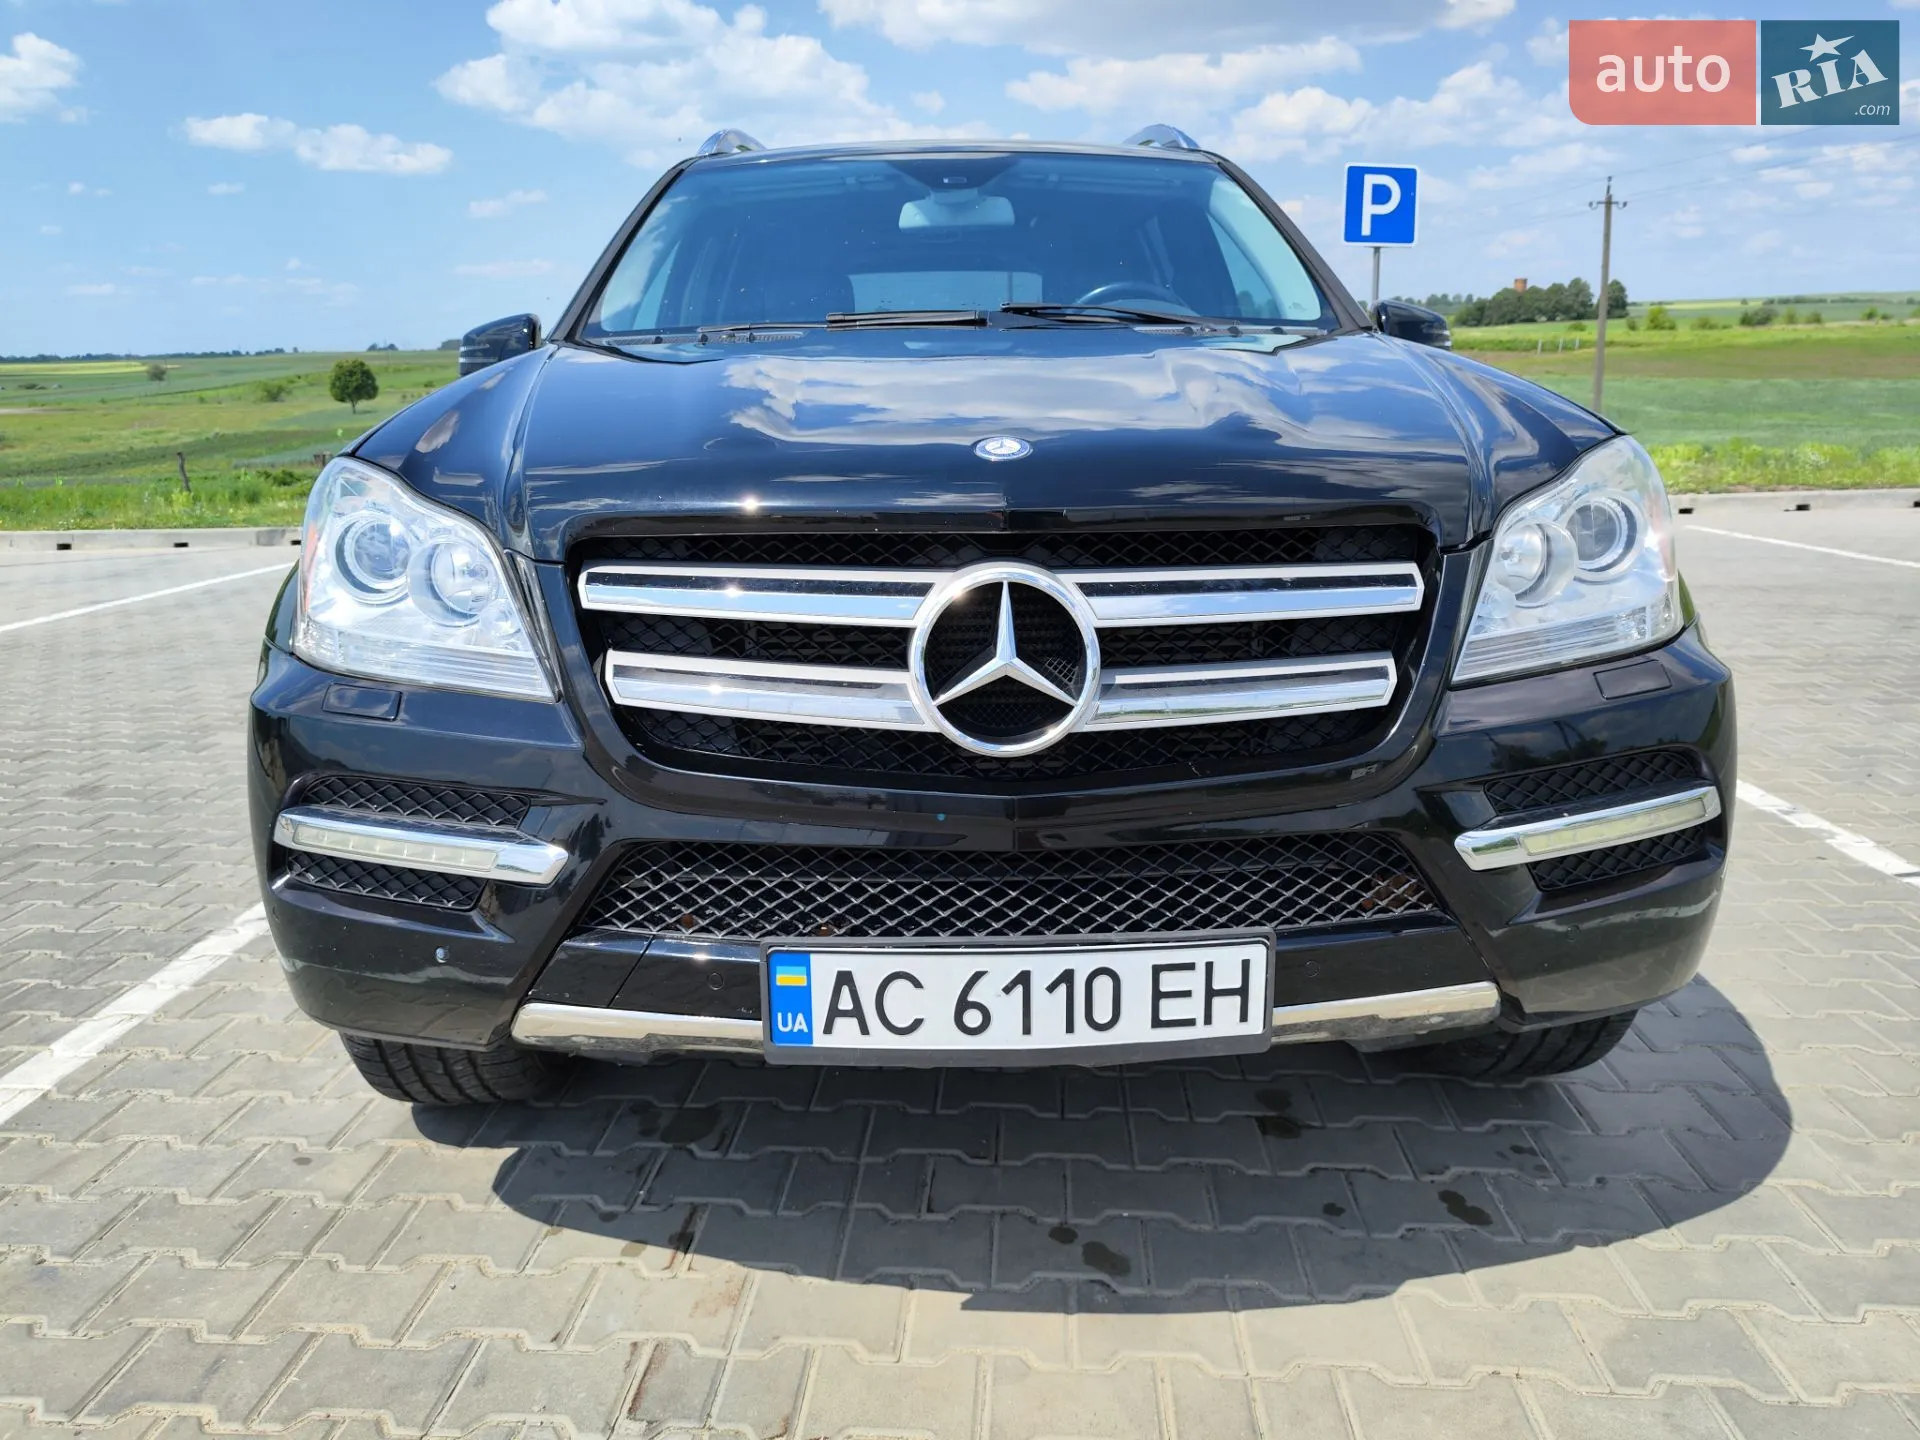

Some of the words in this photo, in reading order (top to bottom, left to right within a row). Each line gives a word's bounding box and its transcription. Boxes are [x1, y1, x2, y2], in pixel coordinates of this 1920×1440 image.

[1361, 173, 1401, 236] P
[777, 1012, 809, 1033] UA
[822, 969, 925, 1037] AC
[953, 966, 1122, 1037] 6110
[1150, 958, 1251, 1029] EH
